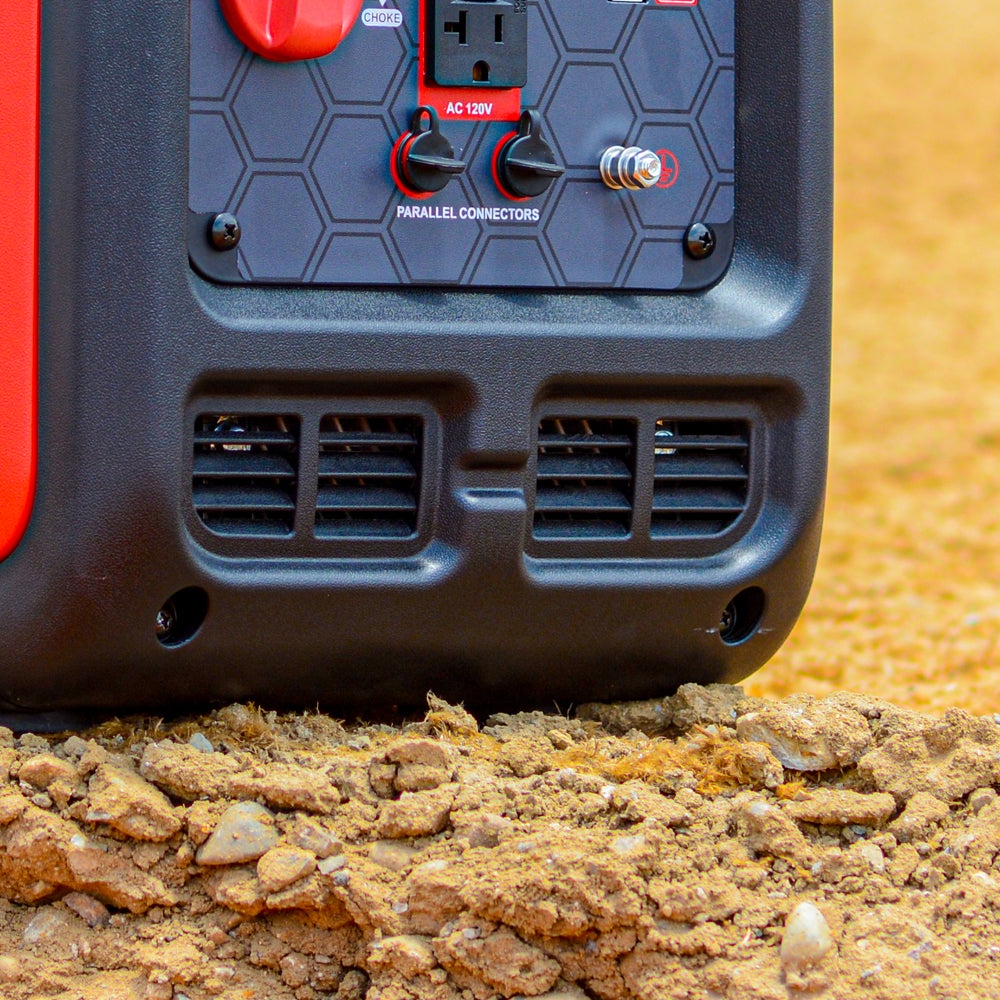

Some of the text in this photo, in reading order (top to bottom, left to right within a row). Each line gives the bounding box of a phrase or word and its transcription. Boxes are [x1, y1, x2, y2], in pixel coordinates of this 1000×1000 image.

[364, 13, 400, 24] CHOKE
[446, 102, 493, 115] AC 120V
[397, 206, 540, 221] PARALLEL CONNECTORS
